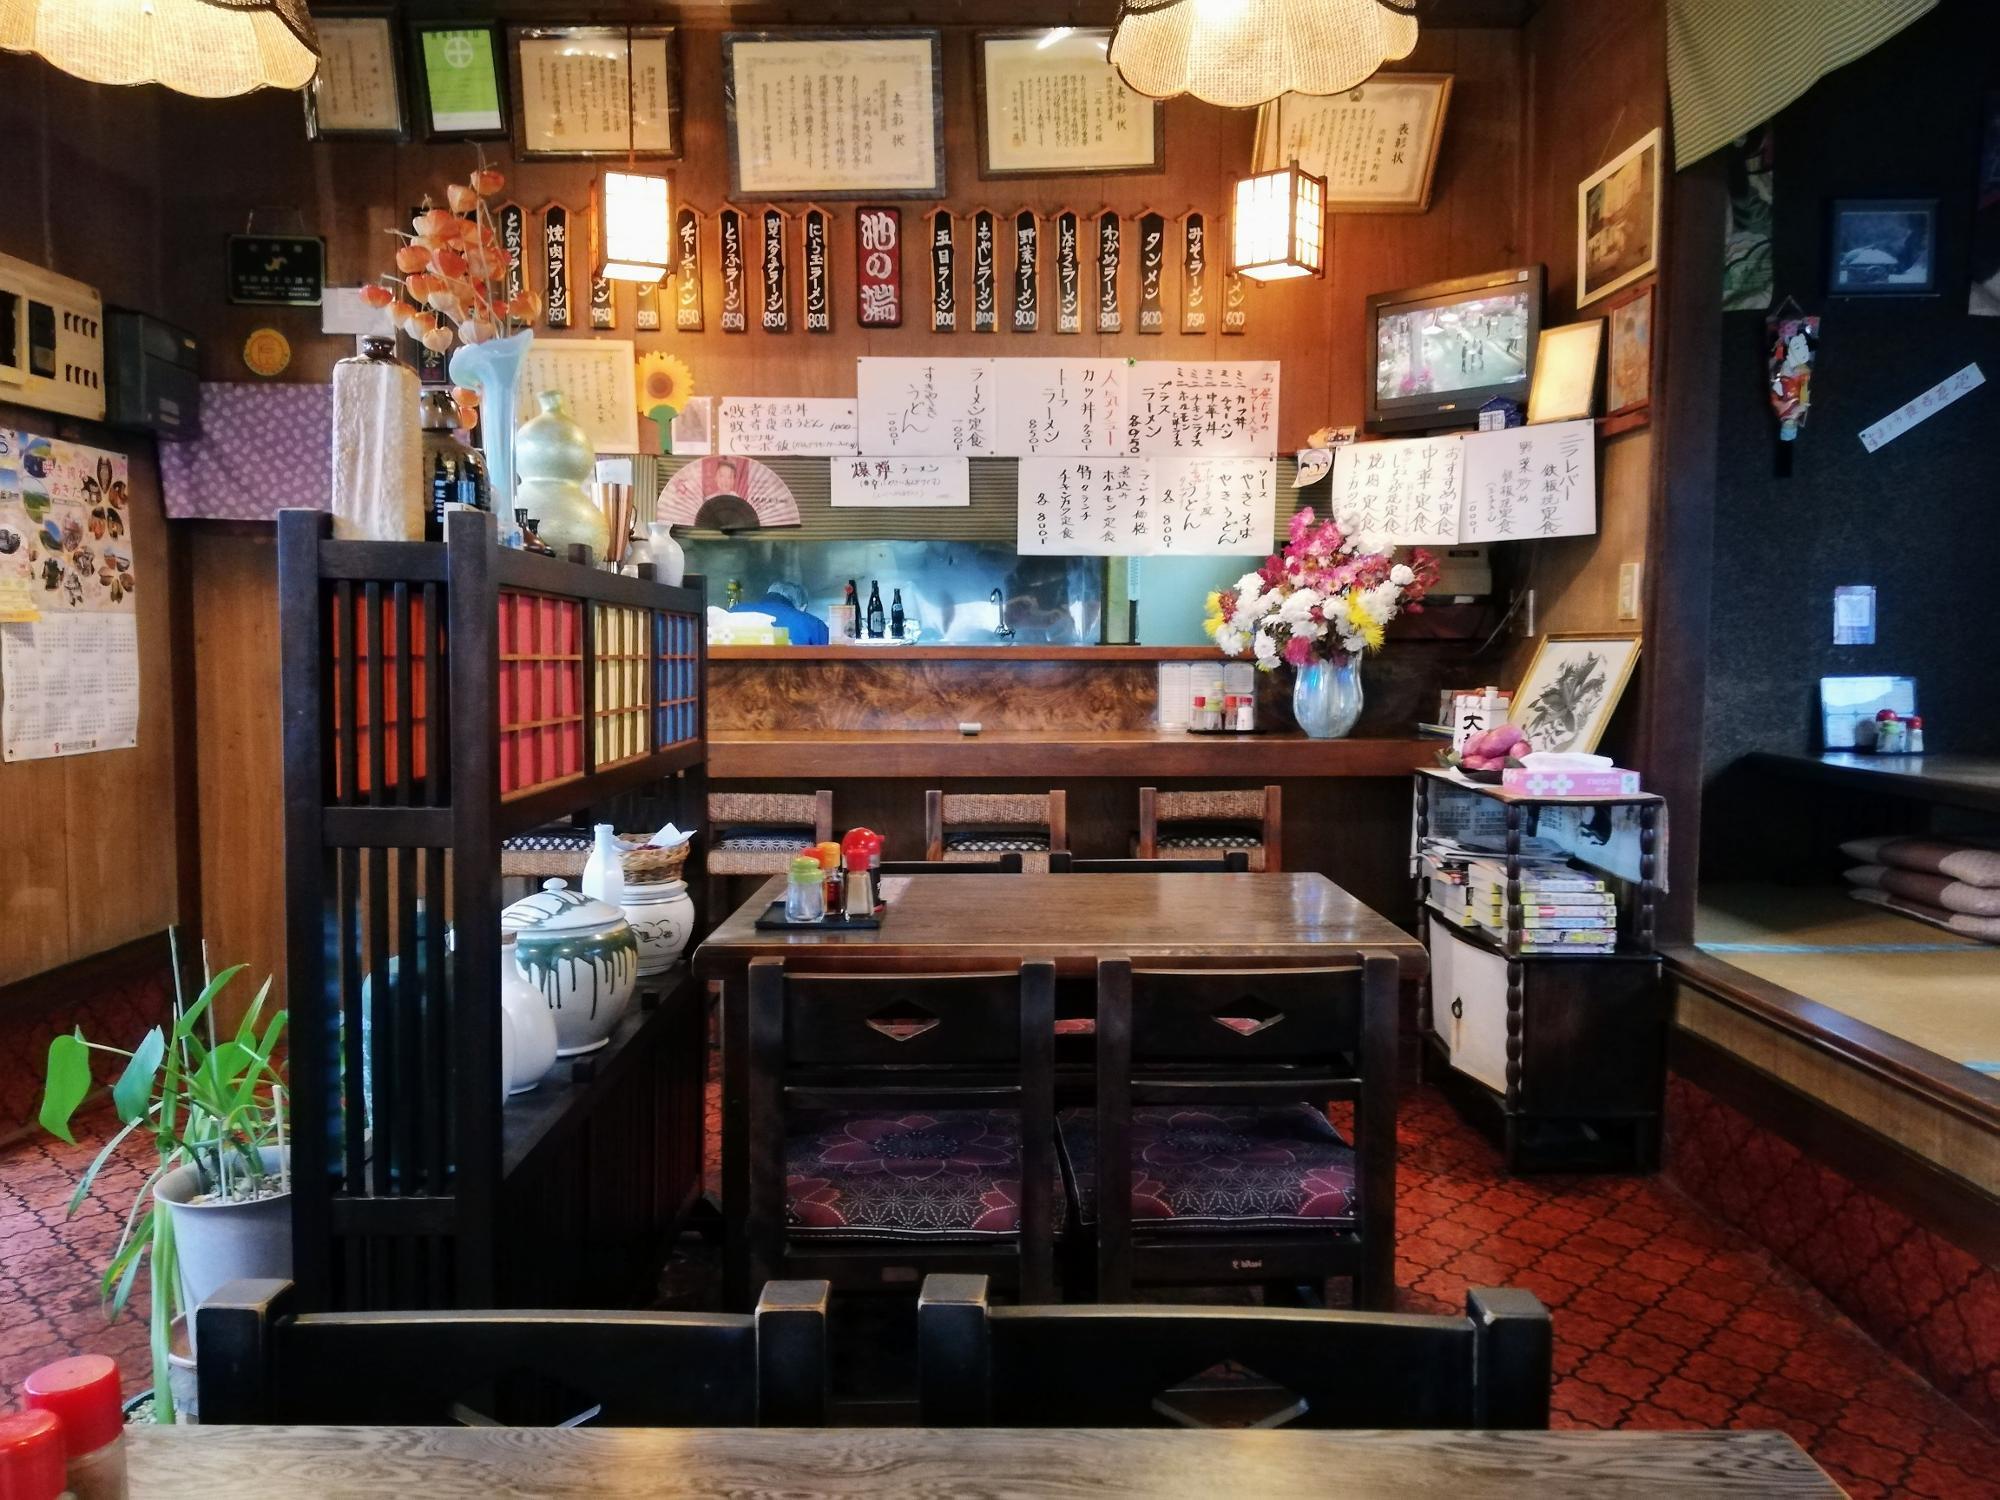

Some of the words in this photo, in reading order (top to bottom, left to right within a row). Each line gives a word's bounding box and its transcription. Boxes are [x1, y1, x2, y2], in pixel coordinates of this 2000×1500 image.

[546, 224, 565, 308] 焼肉ラーメン
[724, 221, 741, 311] とうふラーメン
[807, 223, 825, 311] にら玉ラーメン
[935, 229, 952, 310] 五目ラーメン
[975, 221, 992, 310] もやしラーメン
[1018, 227, 1036, 310] 野菜ラーメン
[1101, 224, 1119, 313] わかめラーメン
[1144, 232, 1160, 300] タンメン
[1187, 226, 1204, 308] みそラーメン
[548, 307, 567, 321] 950
[592, 307, 611, 322] 950
[677, 309, 700, 326] 850
[721, 311, 745, 328] 850
[763, 311, 786, 327] 850
[807, 312, 828, 328] 800
[935, 310, 955, 326] 800
[975, 310, 995, 325] 800
[1060, 314, 1079, 330] 800
[1100, 312, 1121, 329] 800
[1141, 310, 1163, 328] 800
[1225, 310, 1246, 327] 600
[967, 367, 987, 449] ラーメン定食
[1042, 387, 1061, 444] ラーメン
[1080, 368, 1096, 424] カツ丼
[1141, 387, 1163, 439] ラーメン
[1557, 433, 1585, 501] ニラレバー
[1099, 470, 1117, 542] ホルモン定食
[1217, 473, 1238, 545] やきうどん
[1240, 473, 1255, 539] やきそば
